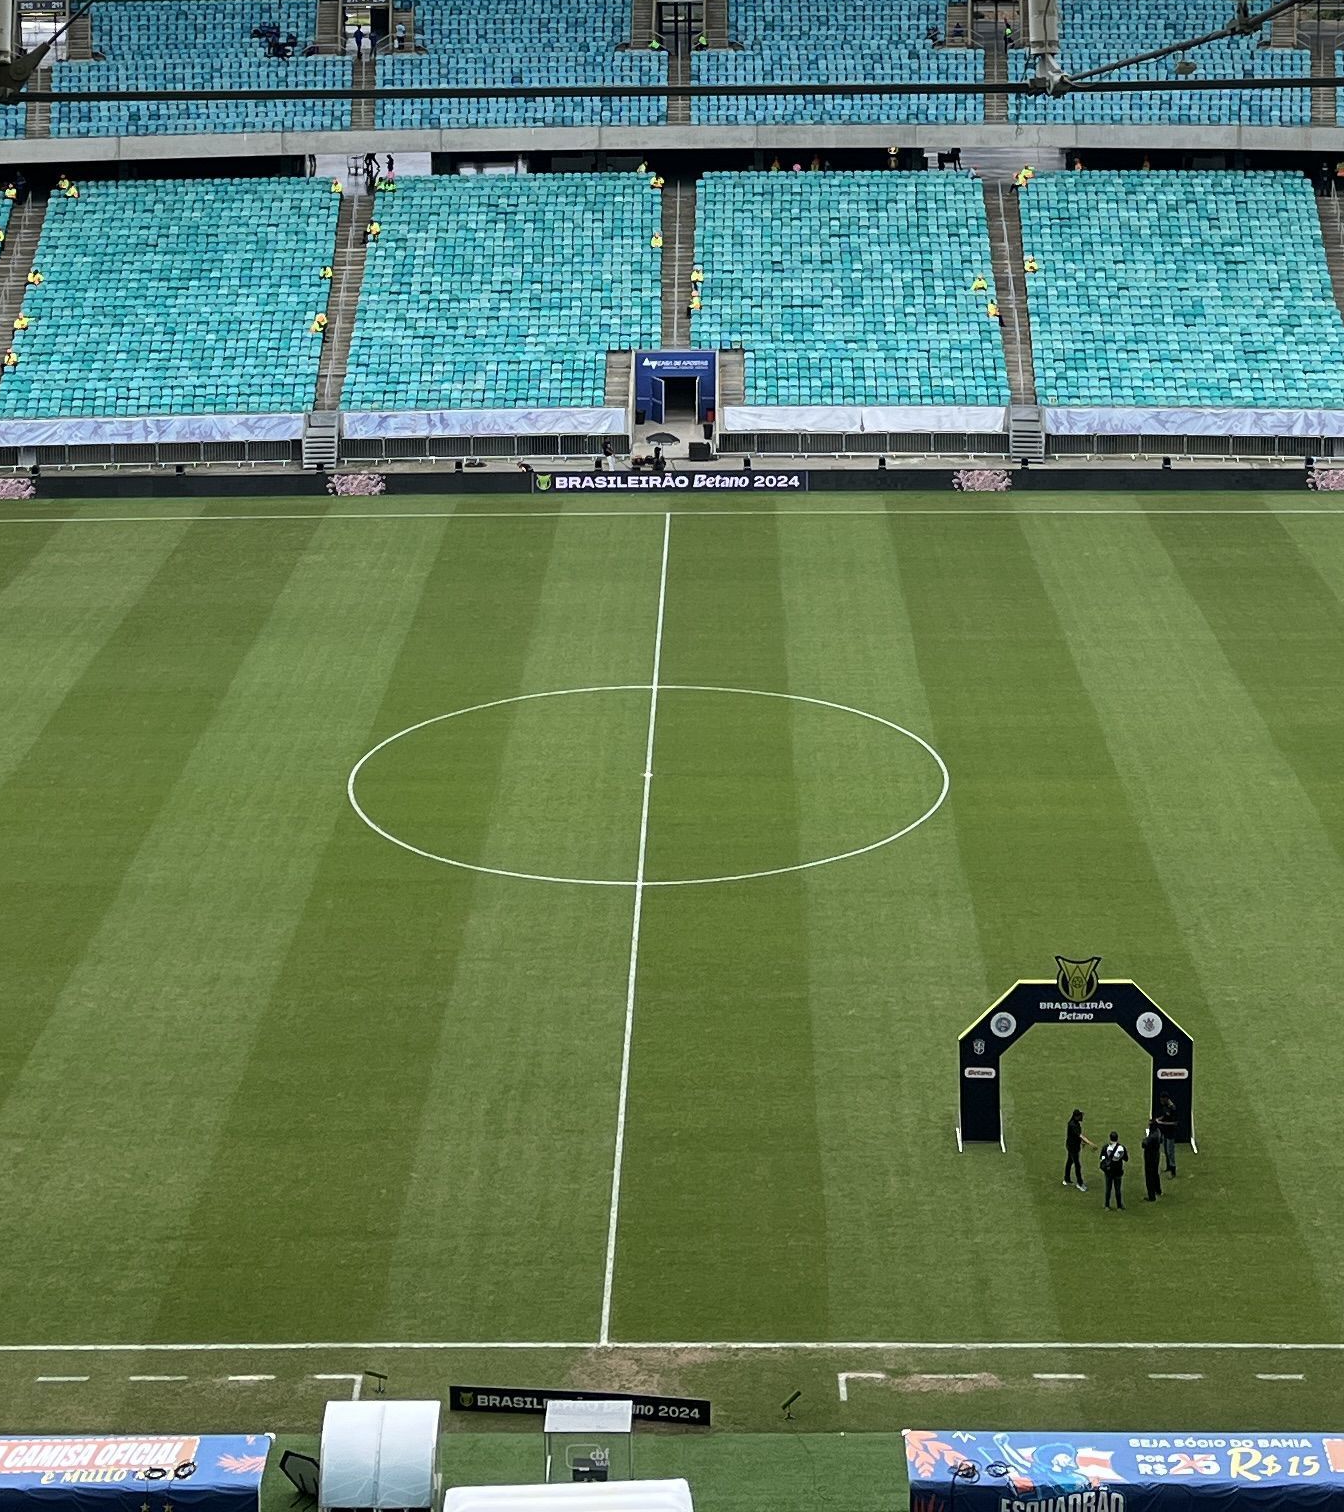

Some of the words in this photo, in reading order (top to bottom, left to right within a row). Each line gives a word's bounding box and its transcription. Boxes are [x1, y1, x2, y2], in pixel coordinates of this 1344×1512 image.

[555, 472, 689, 488] BRASILEIRÃO
[693, 473, 749, 488] Betano
[754, 474, 801, 487] 2024
[1040, 1000, 1114, 1009] BRASILEIRÃO
[1058, 1011, 1094, 1021] Betano
[658, 1405, 701, 1420] 2024
[1128, 1438, 1170, 1448] SEJA
[1174, 1436, 1226, 1448] SÓCIO
[1230, 1438, 1256, 1448] DO
[1259, 1438, 1312, 1448] BAHIA
[3, 1443, 94, 1469] CAMISA
[97, 1441, 183, 1466] OFICIAL
[590, 1447, 609, 1460] cbf
[1136, 1454, 1164, 1463] POR
[1138, 1463, 1167, 1476] R$
[1227, 1446, 1282, 1481] R$
[1288, 1456, 1320, 1476] 15
